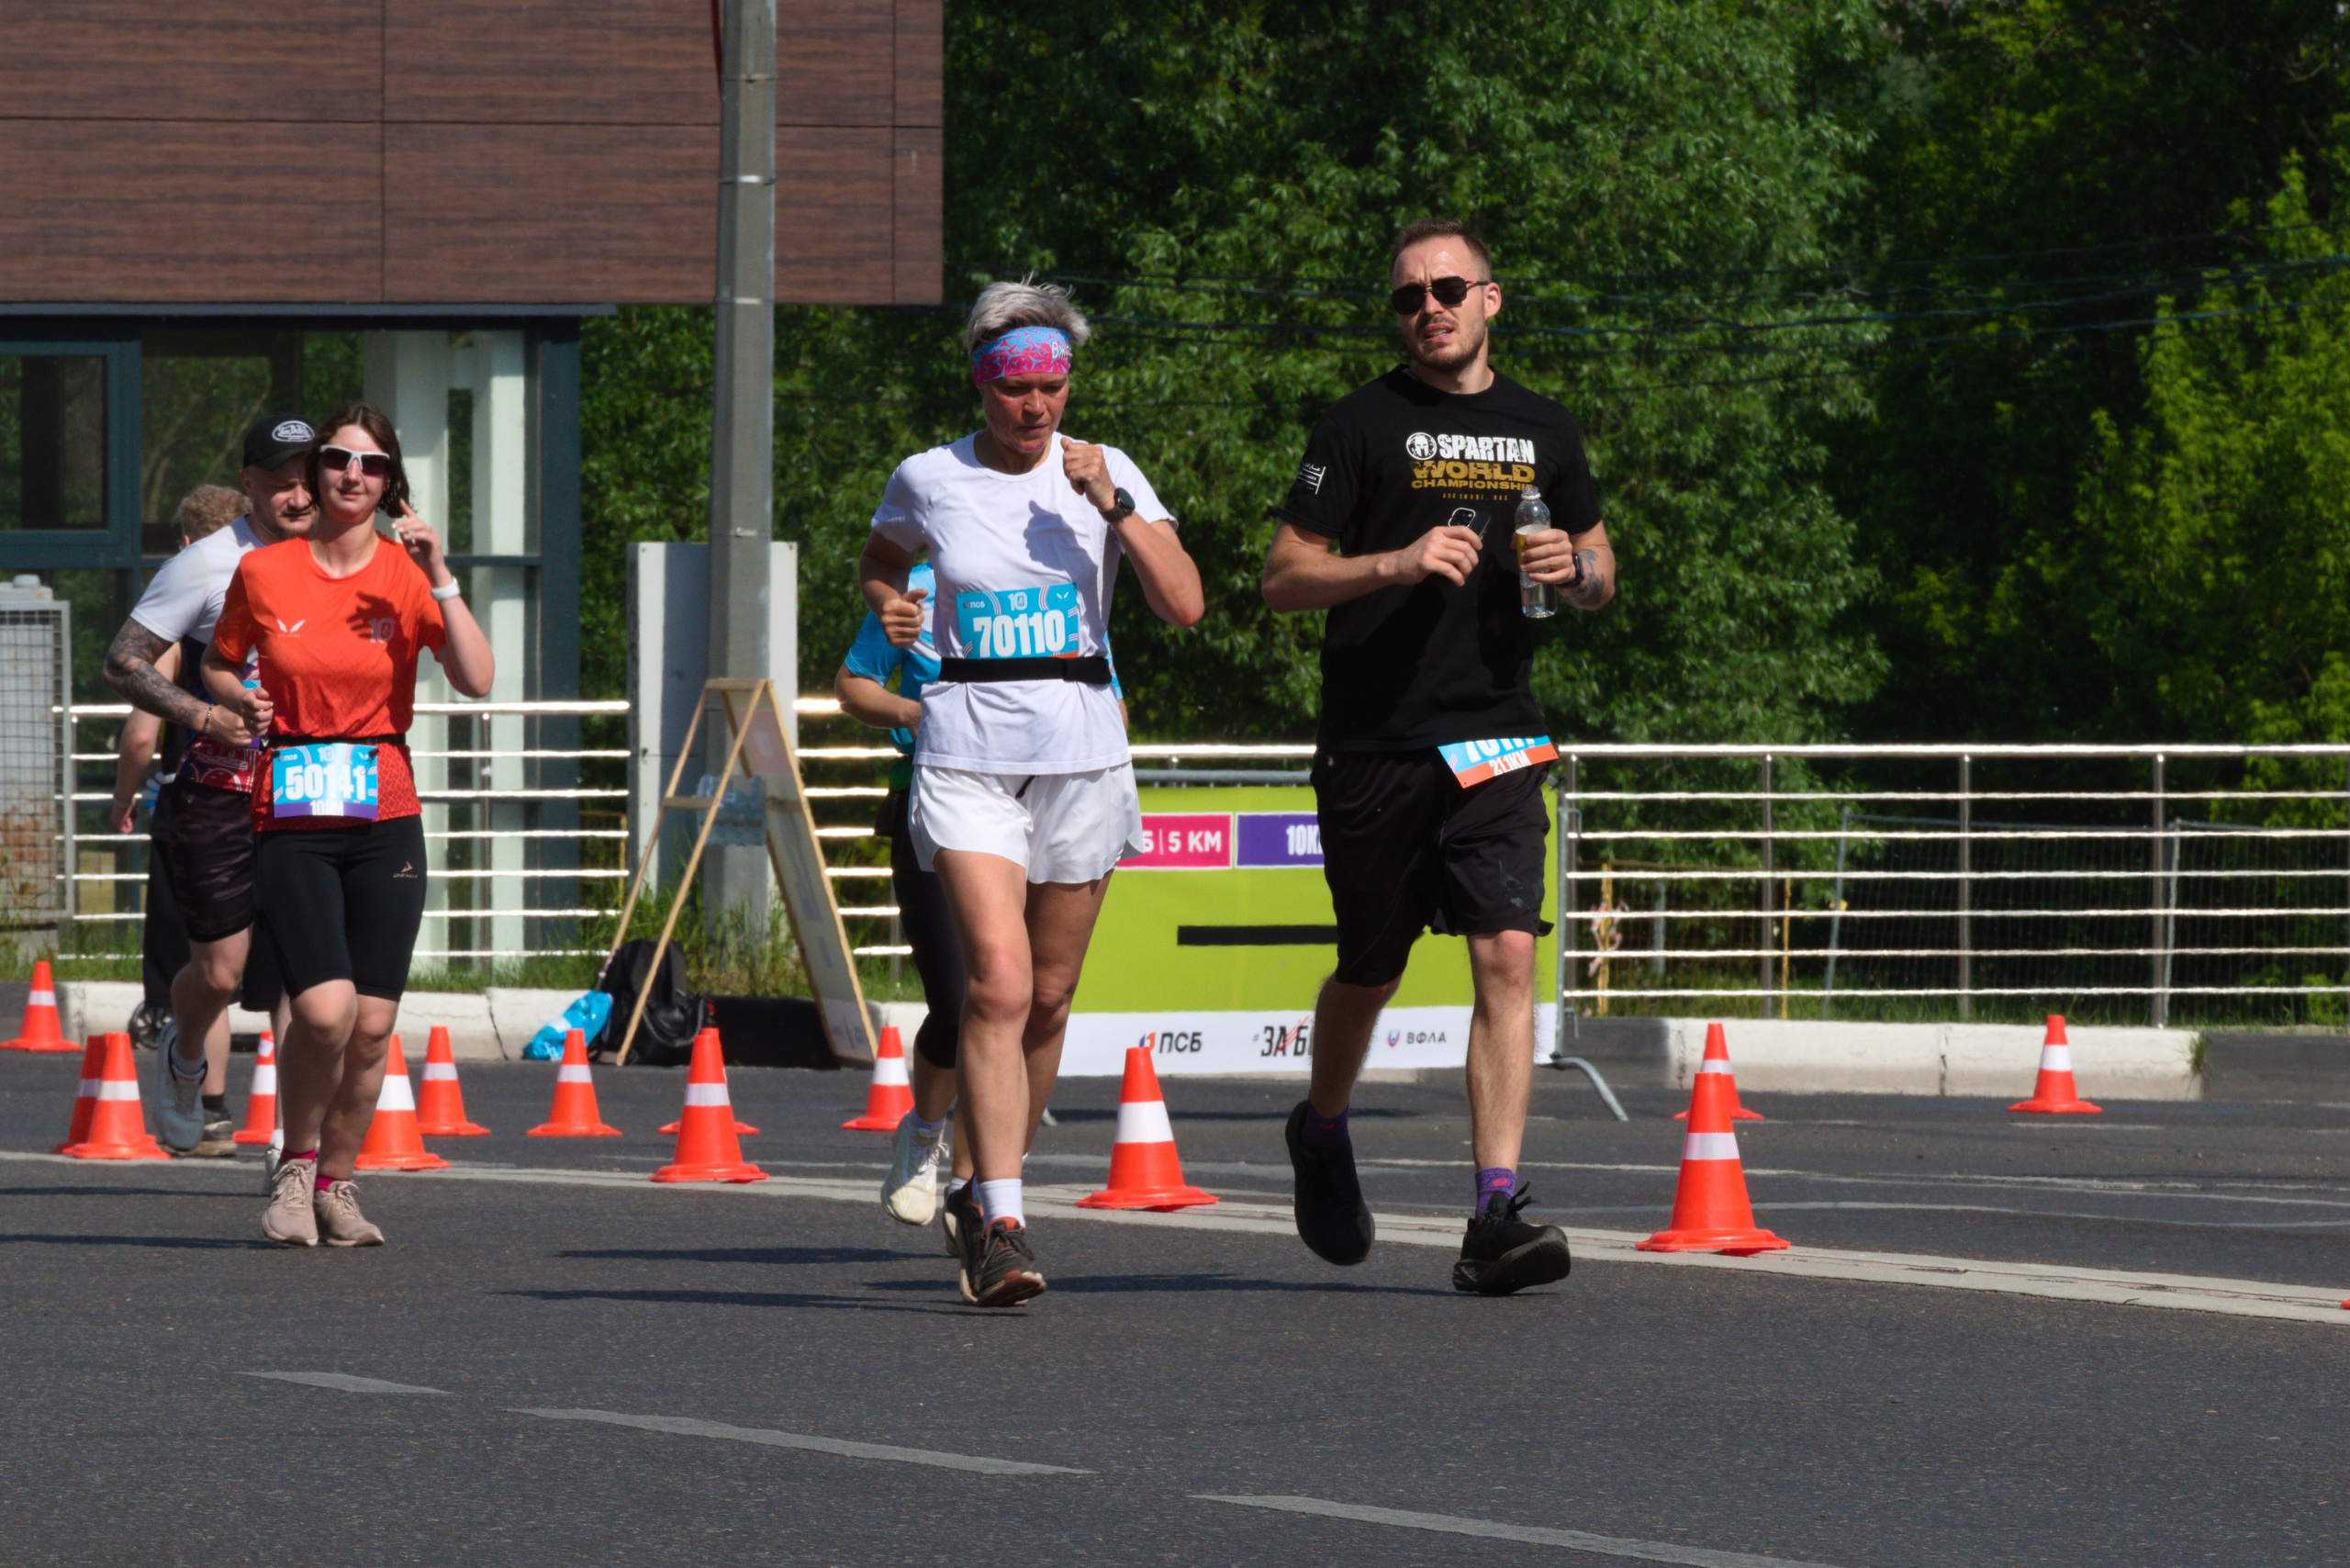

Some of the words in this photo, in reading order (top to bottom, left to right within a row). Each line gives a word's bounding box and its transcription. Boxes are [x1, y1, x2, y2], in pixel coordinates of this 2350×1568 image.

[1437, 434, 1536, 465] SPARTAN
[1409, 460, 1536, 484] WORLD
[367, 617, 396, 644] 10
[973, 610, 1066, 659] 70110
[285, 763, 366, 801] 50141
[1158, 1031, 1203, 1054] ПСБ
